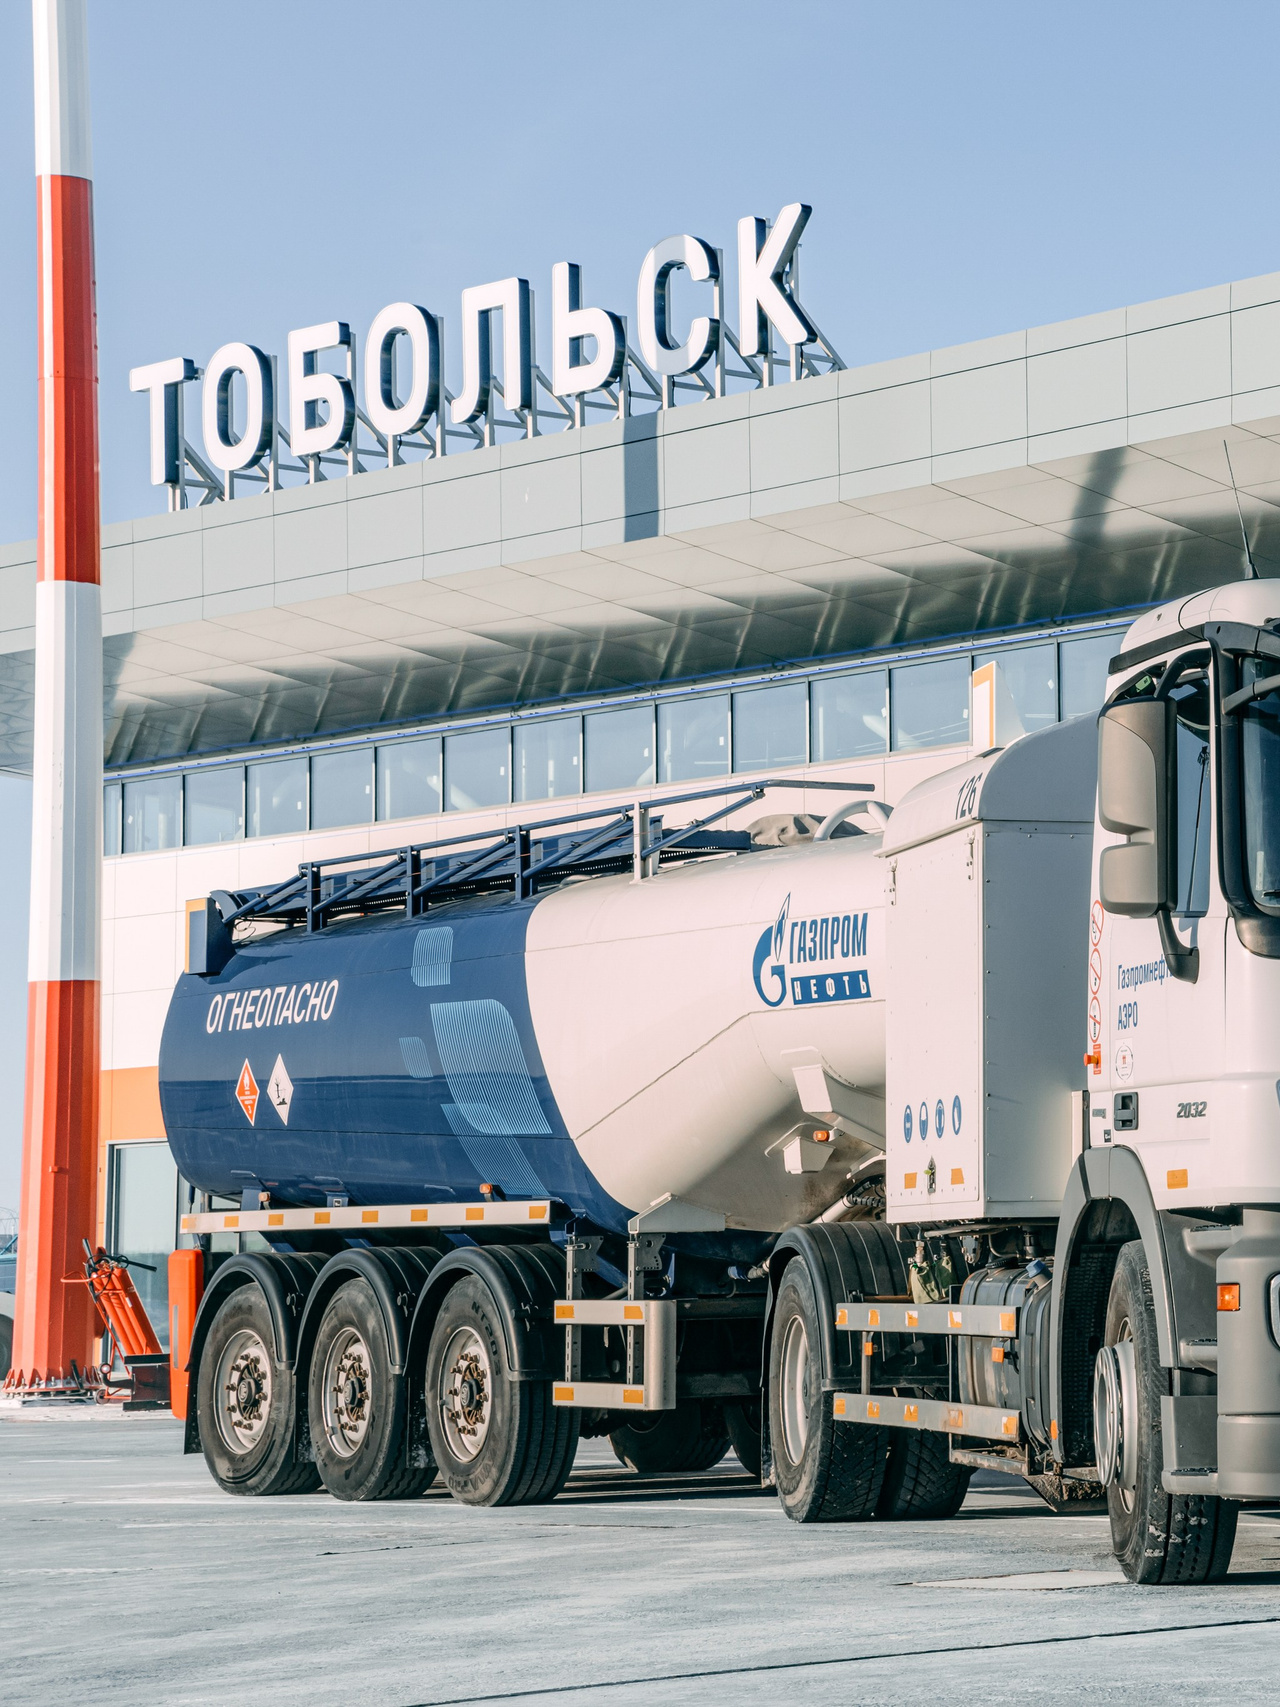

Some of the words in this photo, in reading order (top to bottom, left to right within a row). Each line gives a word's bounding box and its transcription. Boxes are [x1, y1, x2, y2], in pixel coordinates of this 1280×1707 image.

[129, 203, 817, 488] ТОБОЛЬСК
[955, 772, 983, 820] 126
[789, 912, 868, 964] ГАЗПРОМ
[206, 979, 339, 1034] ОГНЕОПАСНО
[793, 973, 868, 1001] НЕФТЬ
[1117, 1000, 1139, 1031] АЭРО
[1177, 1101, 1208, 1119] 2032
